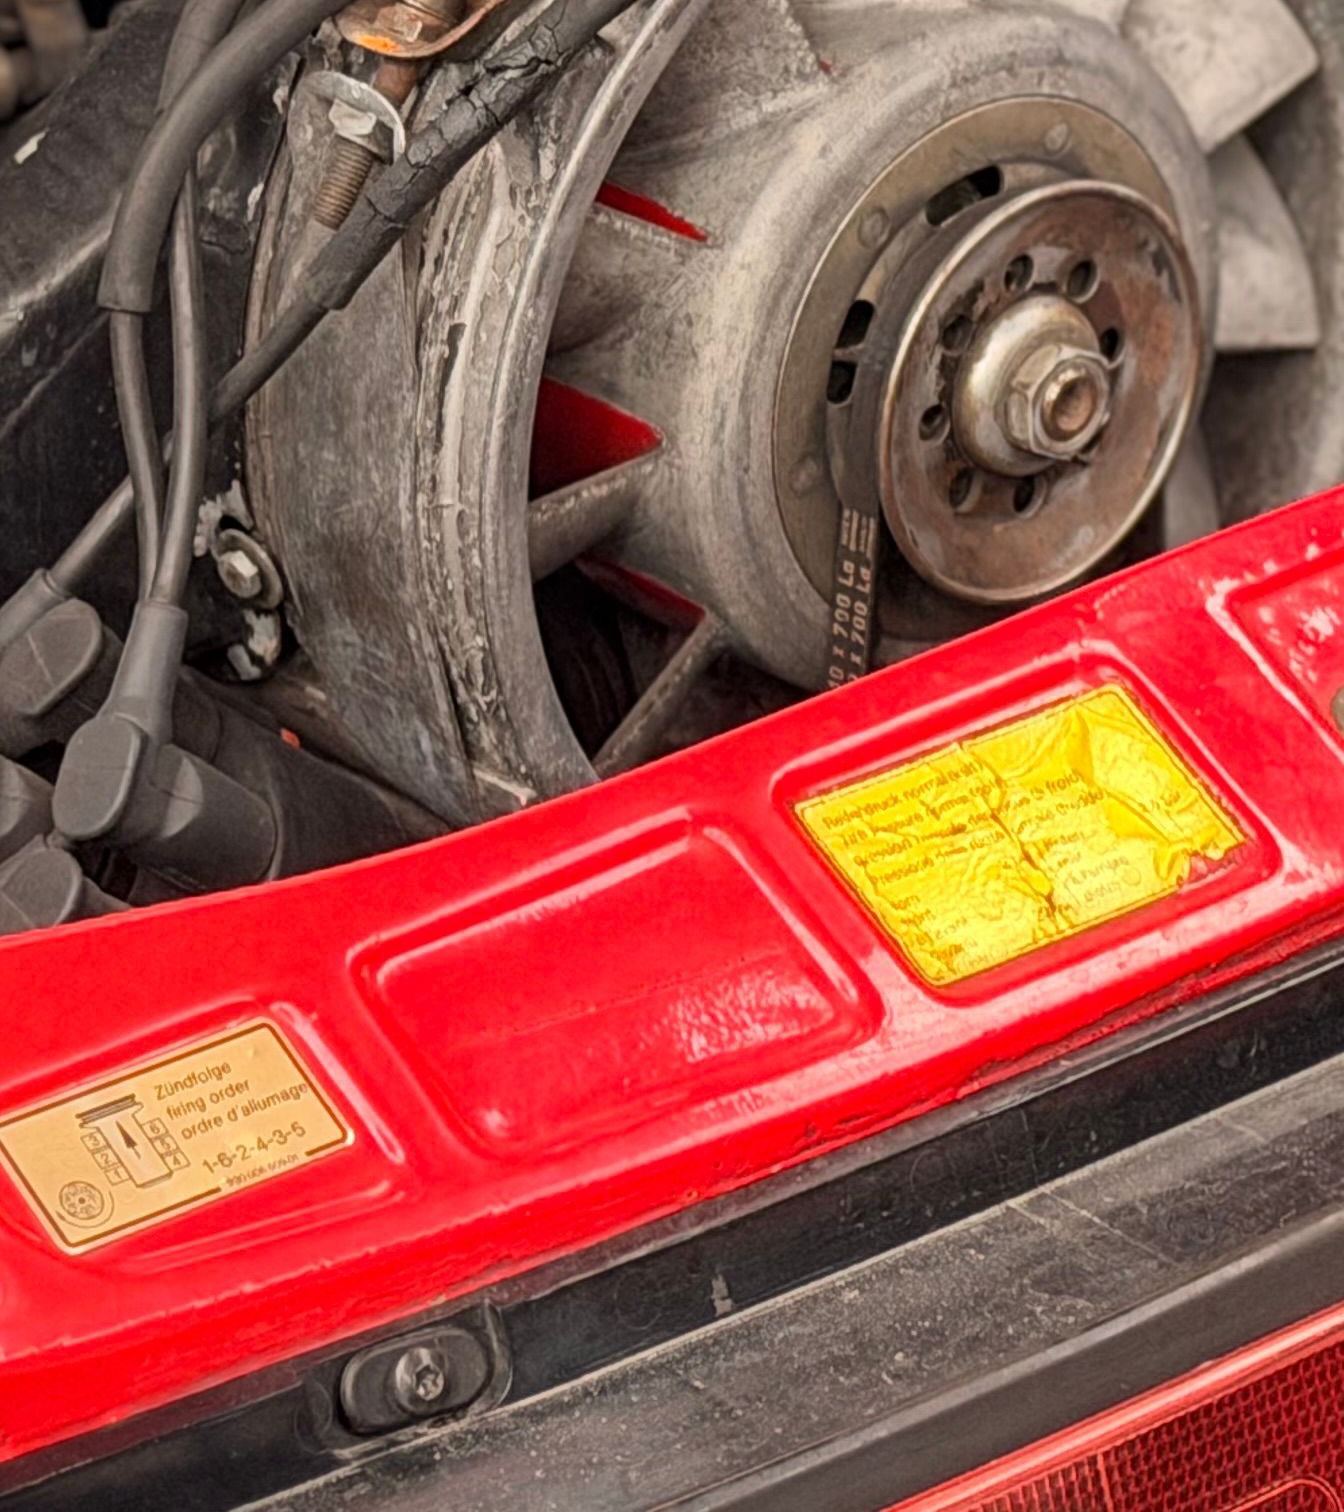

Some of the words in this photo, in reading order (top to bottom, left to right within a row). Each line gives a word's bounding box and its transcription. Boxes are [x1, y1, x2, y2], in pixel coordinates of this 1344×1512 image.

[154, 1062, 232, 1101] Zündfolge
[166, 1097, 207, 1120] firing
[209, 1079, 250, 1104] order
[181, 1115, 224, 1139] ordre
[227, 1082, 309, 1122] d'allumage
